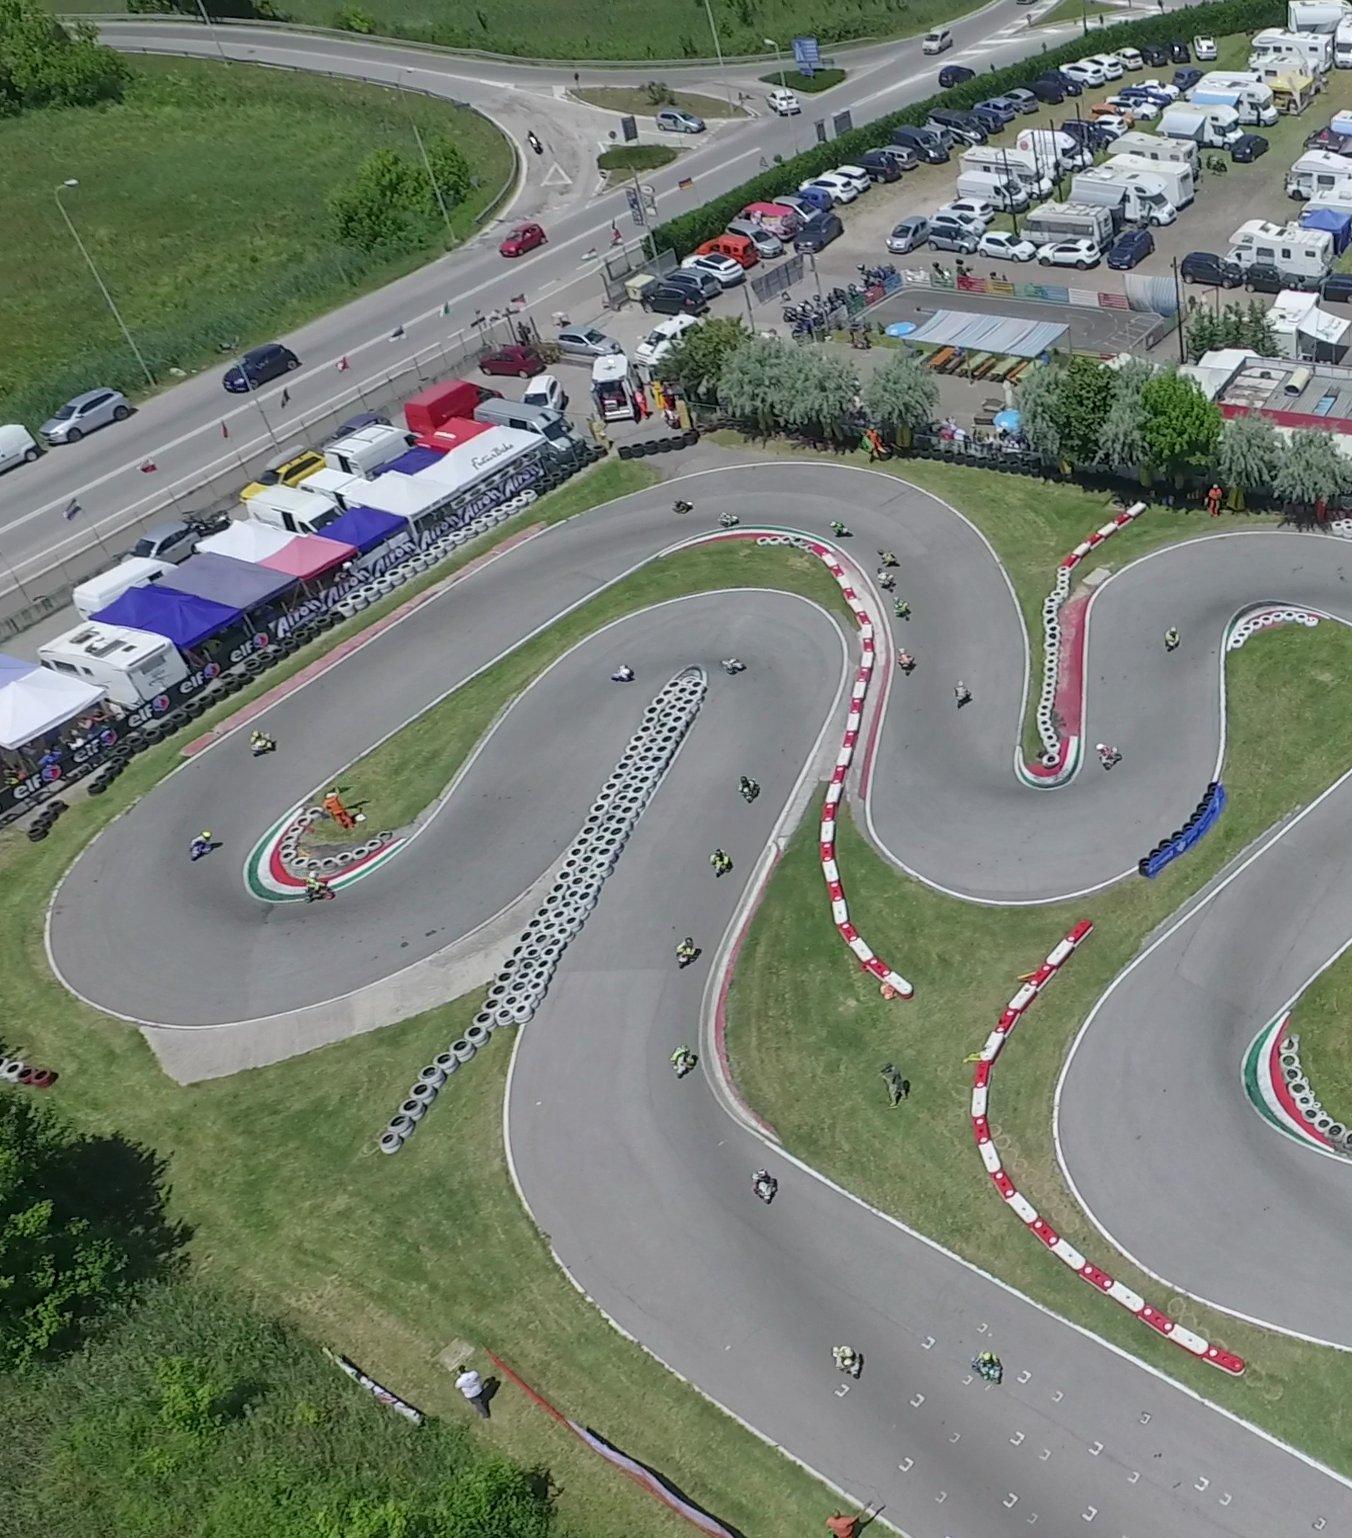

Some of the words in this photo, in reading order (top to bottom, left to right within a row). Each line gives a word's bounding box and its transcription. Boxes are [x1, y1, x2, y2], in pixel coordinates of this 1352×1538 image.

[230, 641, 254, 662] elf
[180, 671, 204, 694] elf
[128, 703, 153, 727] elf
[73, 739, 100, 763] elf
[13, 774, 42, 799] elf
